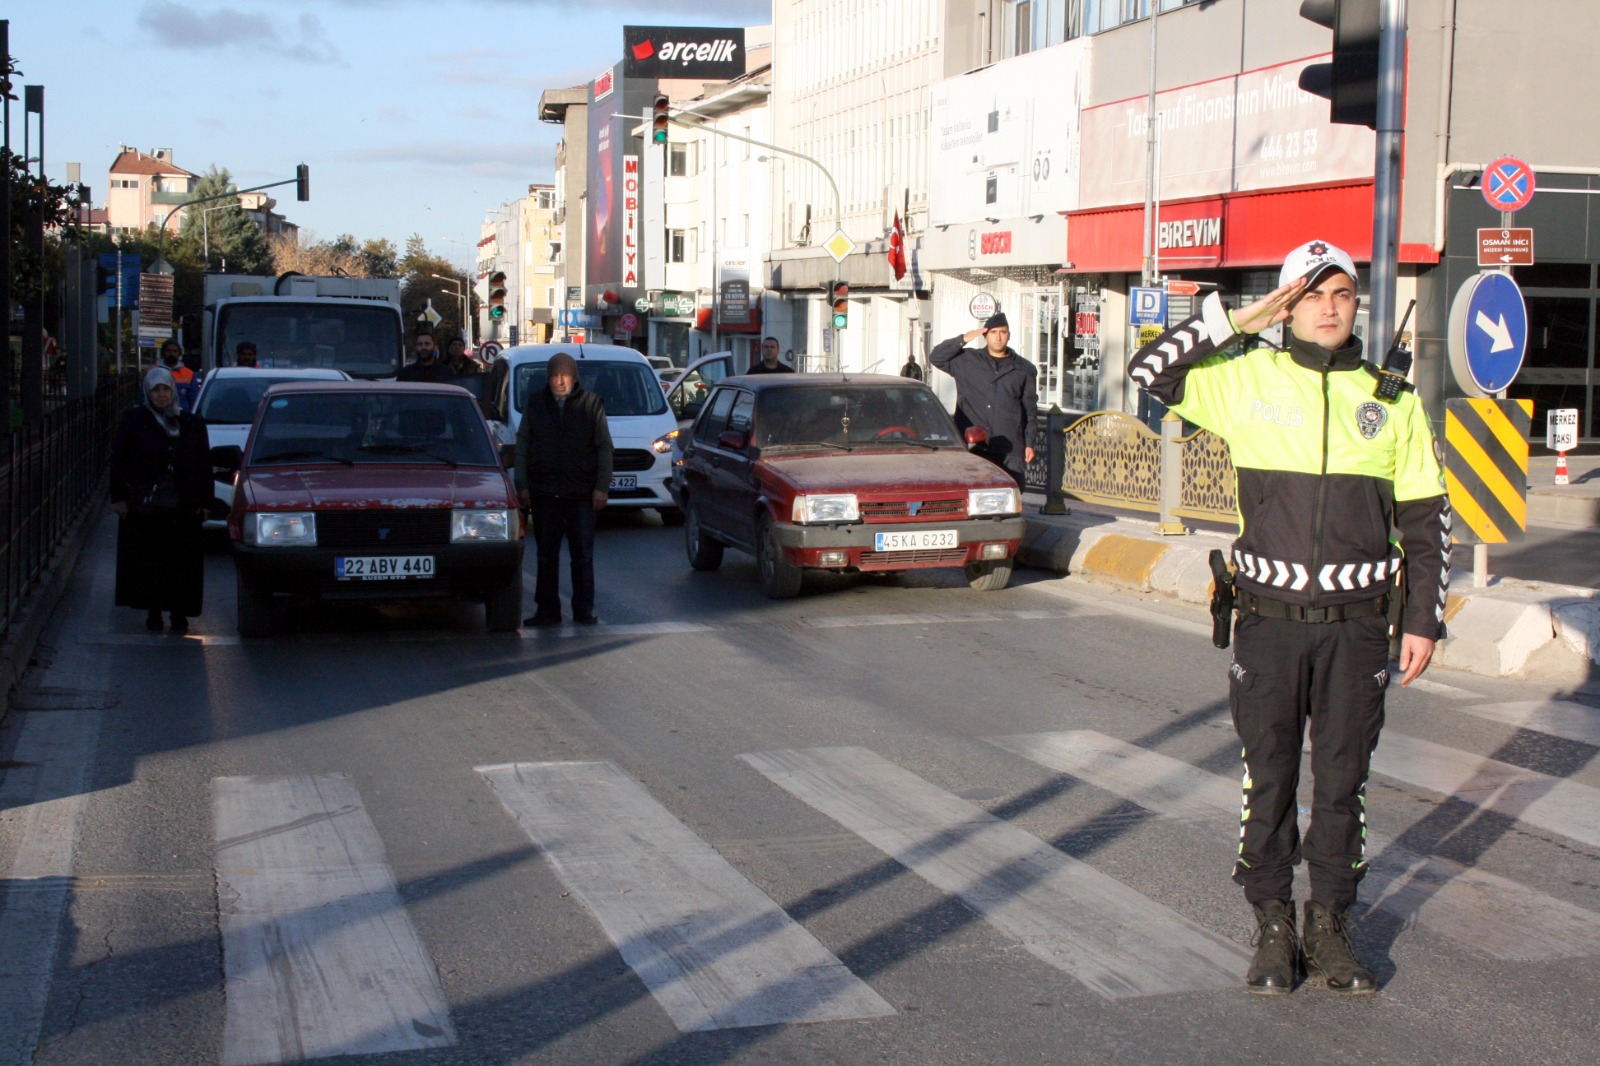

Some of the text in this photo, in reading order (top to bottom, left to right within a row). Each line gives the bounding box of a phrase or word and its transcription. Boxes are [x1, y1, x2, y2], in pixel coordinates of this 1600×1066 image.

[658, 39, 737, 67] arçelik
[1126, 102, 1182, 138] Tasrruf
[1260, 127, 1318, 161] 444 23 53
[1259, 159, 1317, 178] www.birevim.com
[625, 160, 638, 284] MOBİLYA
[1158, 217, 1221, 249] BİREVİM
[1141, 293, 1156, 311] D
[1251, 399, 1304, 427] POLİS
[1549, 414, 1577, 426] MERKEZ
[619, 477, 635, 488] 422
[922, 533, 954, 546] 6232
[345, 558, 432, 575] 22 ABV 440
